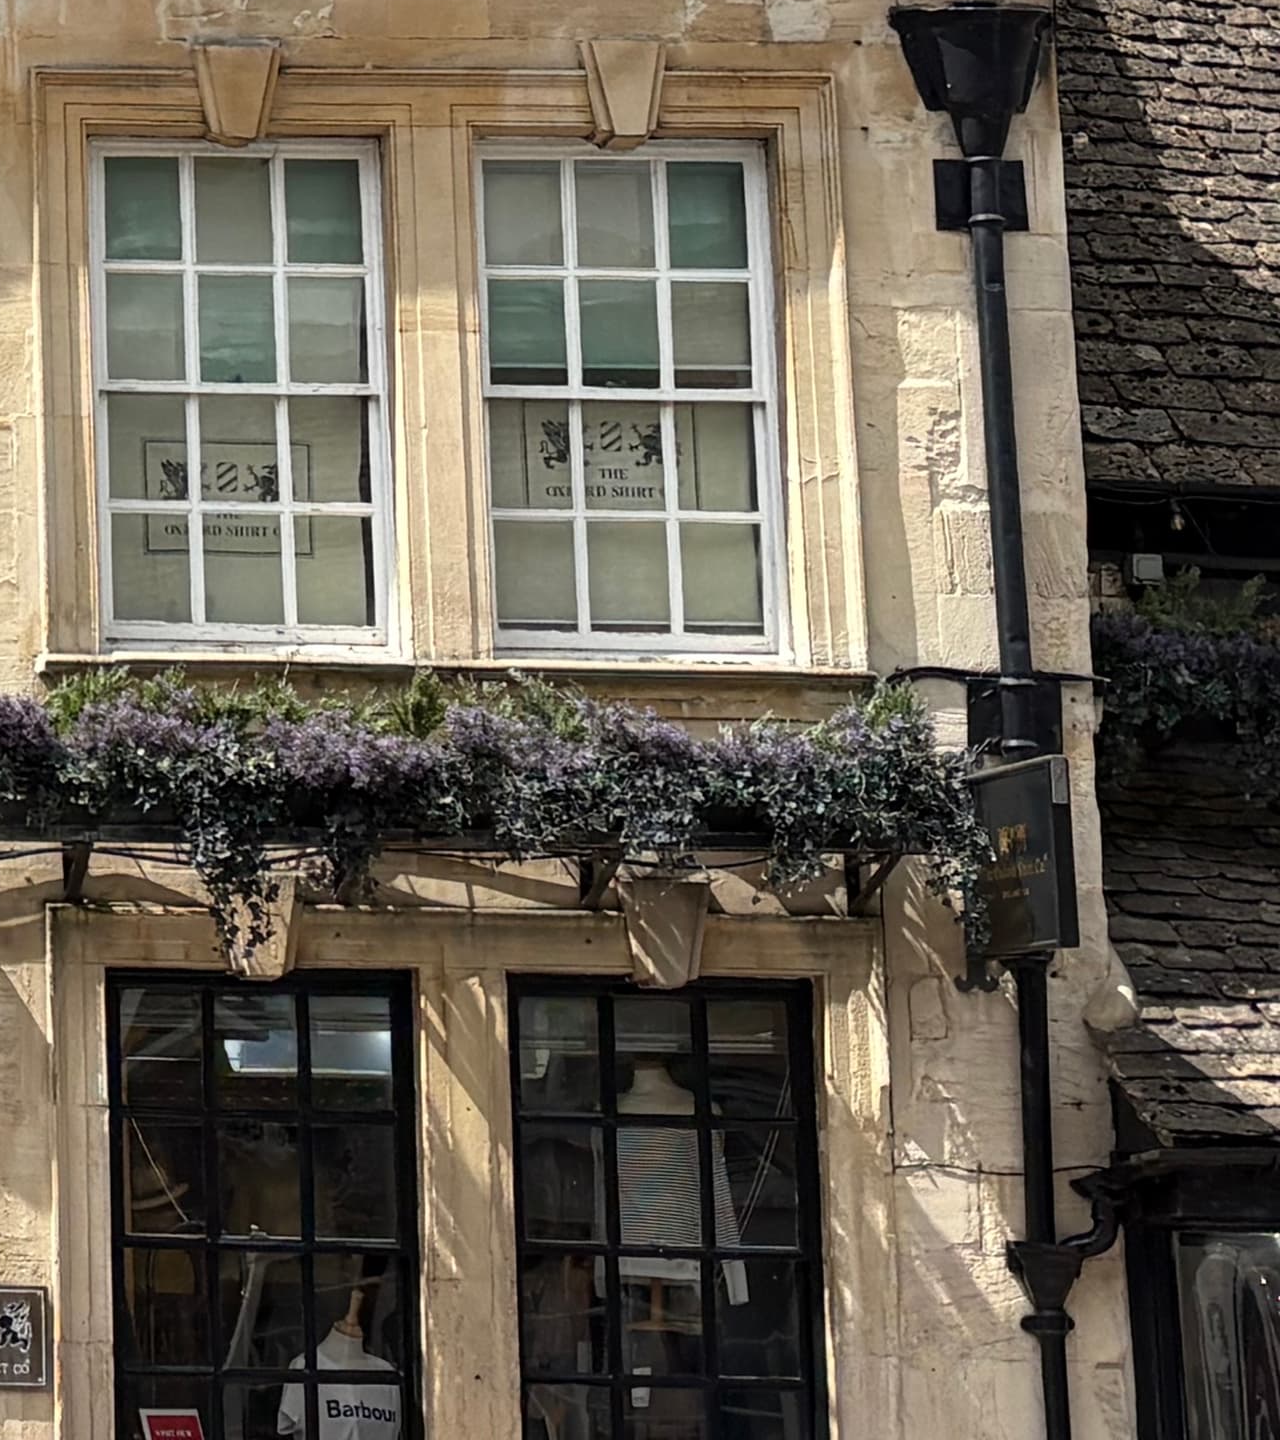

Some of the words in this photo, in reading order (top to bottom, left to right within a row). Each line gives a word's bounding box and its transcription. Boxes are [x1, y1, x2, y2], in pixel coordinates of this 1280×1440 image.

[598, 468, 629, 480] THE
[611, 486, 654, 499] SHIRT
[225, 525, 269, 538] SHIRT
